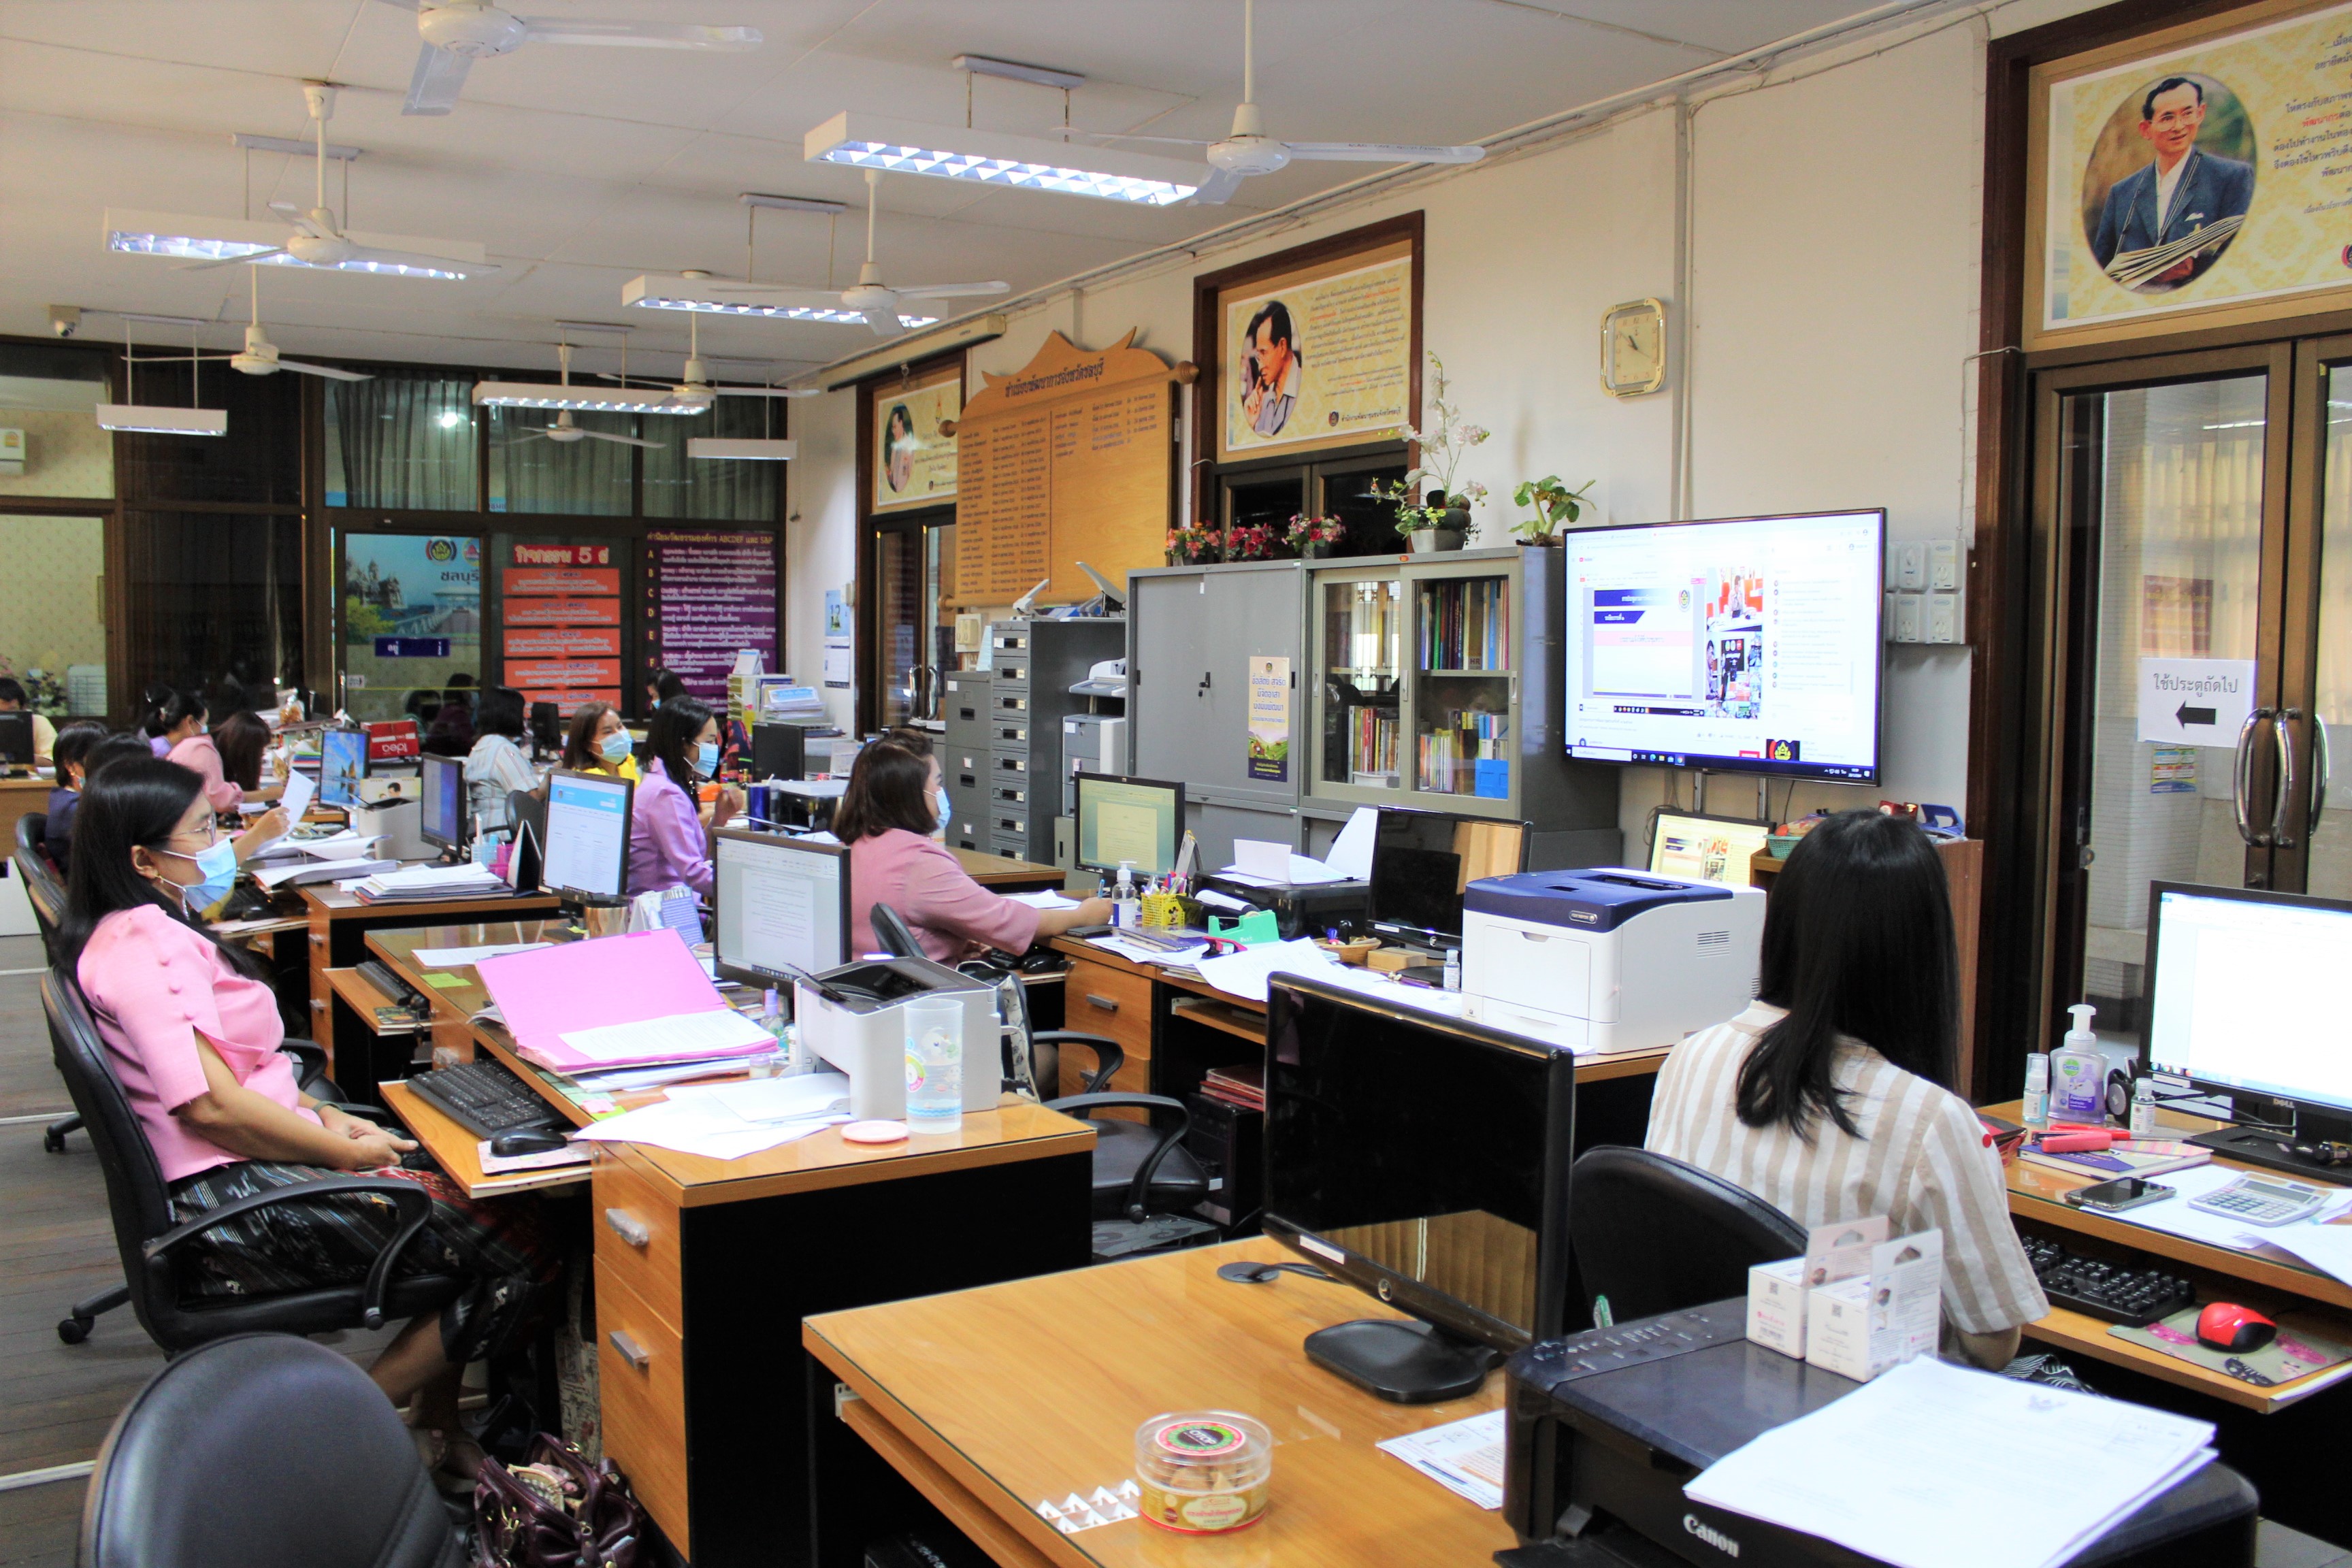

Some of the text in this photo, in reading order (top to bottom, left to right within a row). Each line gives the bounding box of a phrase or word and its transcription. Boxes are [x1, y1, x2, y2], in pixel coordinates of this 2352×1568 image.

[578, 546, 592, 564] 5
[648, 550, 654, 559] A
[648, 569, 654, 578] B
[648, 589, 654, 598] C
[648, 608, 655, 617] D
[649, 631, 655, 640] E
[649, 657, 655, 667] F
[2153, 672, 2238, 698] ใช้ประตูถัดไป
[2273, 1097, 2295, 1109] DELL
[1682, 1513, 1740, 1558] Canon
